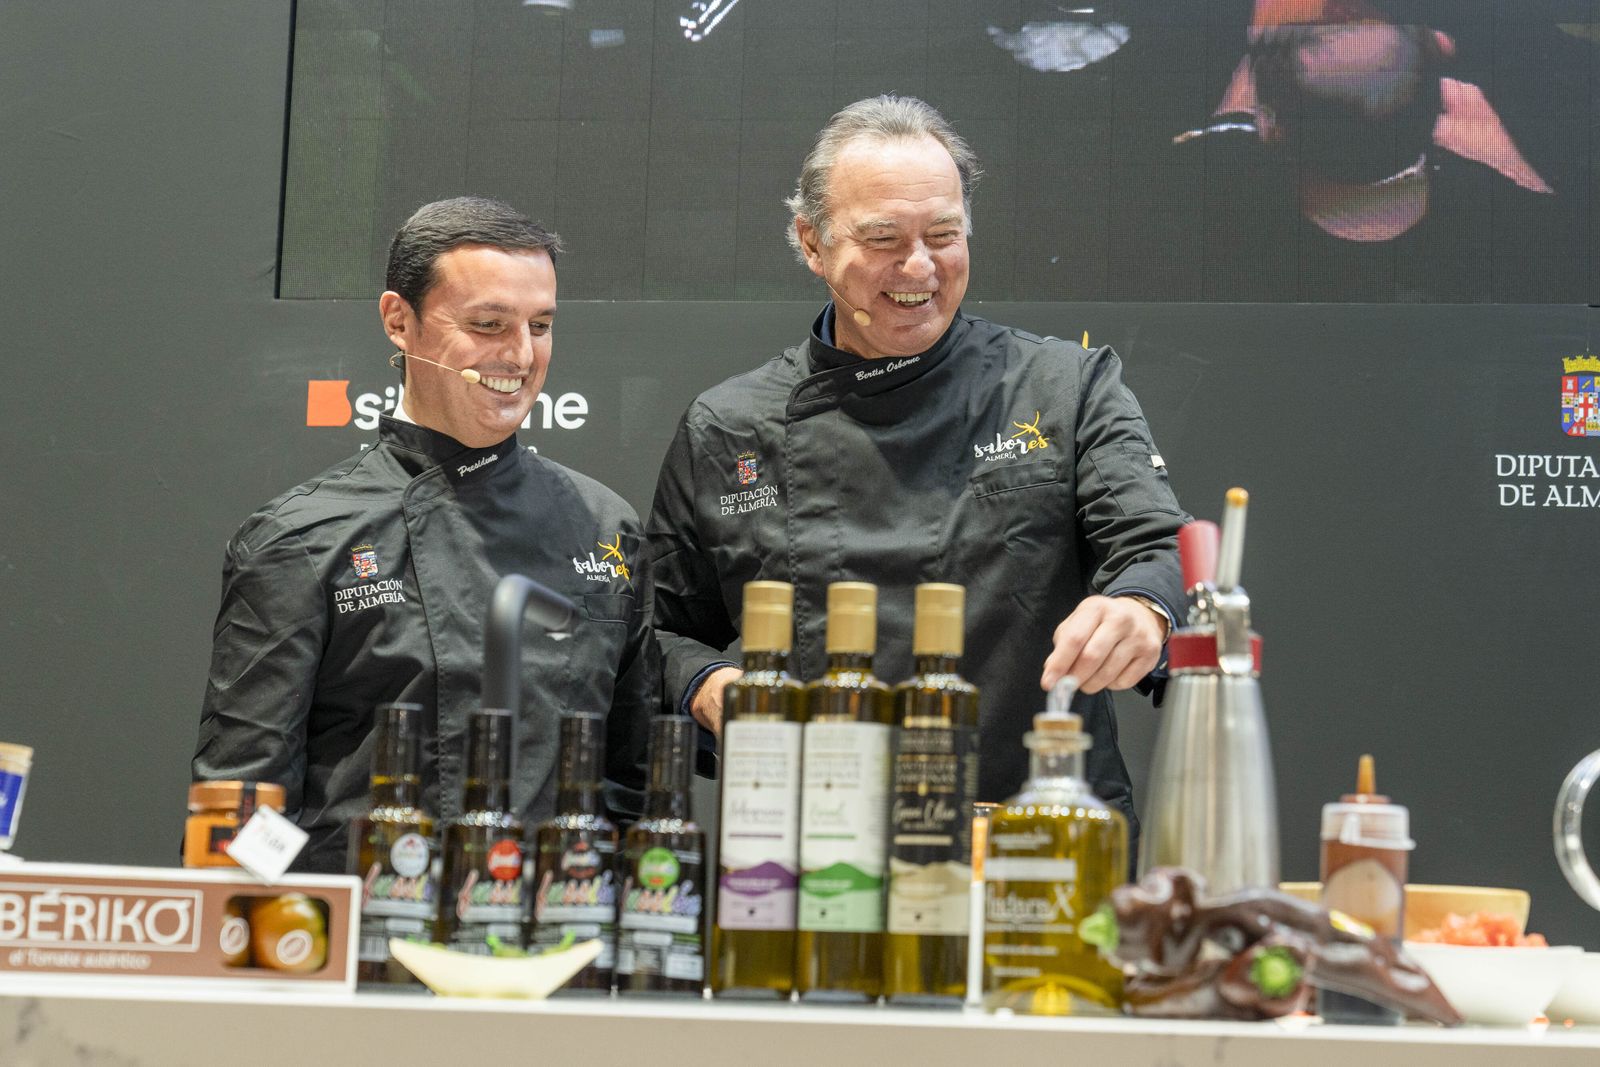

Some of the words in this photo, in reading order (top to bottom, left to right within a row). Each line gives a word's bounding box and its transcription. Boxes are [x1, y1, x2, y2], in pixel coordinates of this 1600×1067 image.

[973, 432, 1050, 458] sabores
[985, 451, 1018, 462] ALMERÍA
[456, 453, 499, 478] Presidente
[1495, 454, 1600, 478] DIPUTA
[720, 484, 779, 505] DIPUTACIÓN
[721, 505, 736, 516] DE
[736, 495, 778, 514] ALMERÍA
[1498, 484, 1536, 507] DE
[1542, 485, 1600, 508] ALM
[334, 578, 403, 602] DIPUTACIÓN
[337, 601, 356, 614] DE
[356, 591, 406, 611] ALMERÍA
